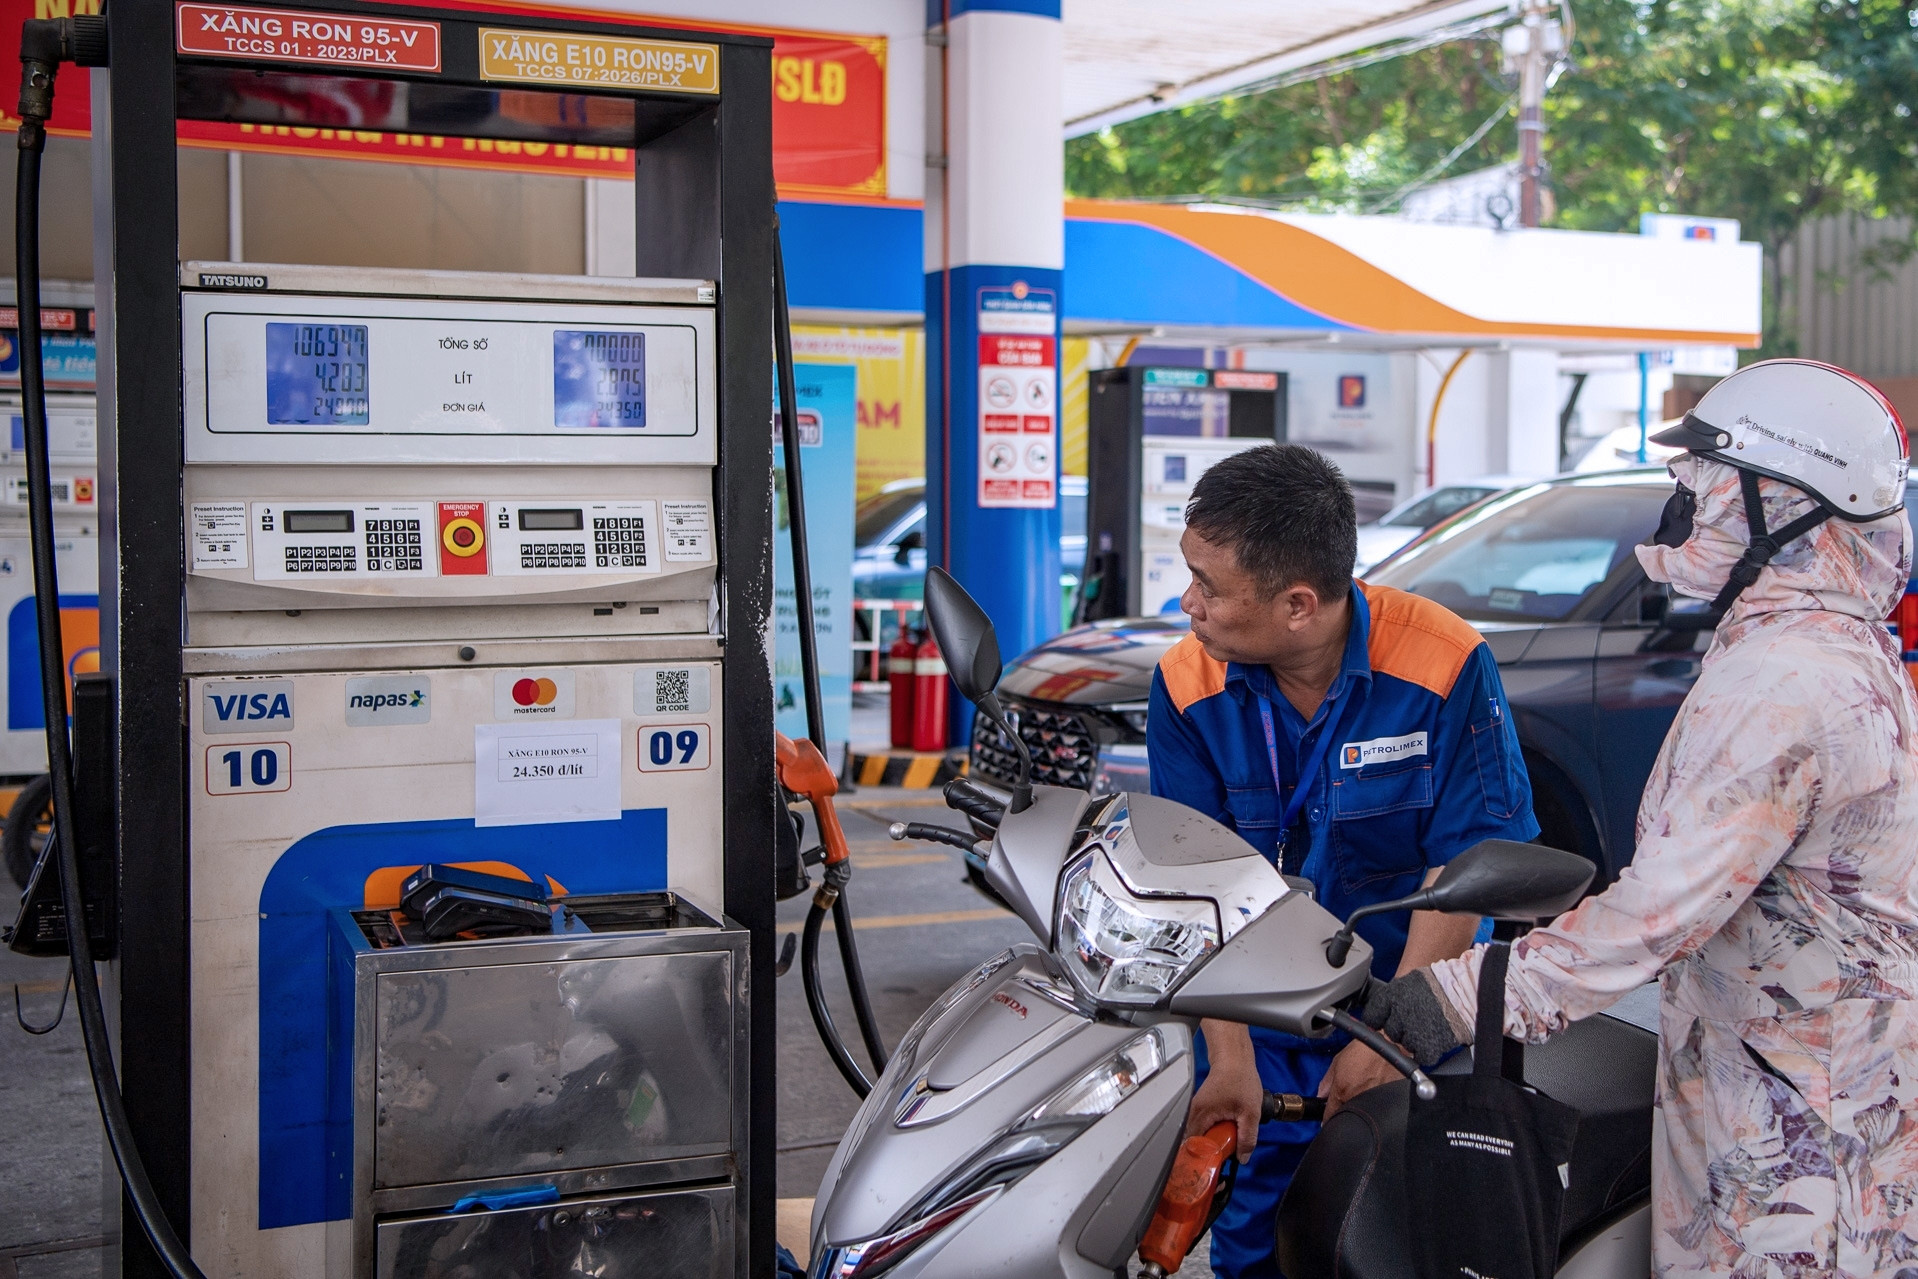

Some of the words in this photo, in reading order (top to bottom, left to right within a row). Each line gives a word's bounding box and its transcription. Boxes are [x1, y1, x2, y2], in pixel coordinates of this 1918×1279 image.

[200, 11, 283, 36] XĂNG
[292, 20, 352, 42] RON
[360, 27, 418, 48] 95-V
[224, 38, 276, 54] TCCS
[280, 42, 300, 55] 01
[318, 45, 397, 62] 2023/PLX
[492, 35, 558, 63] XĂNG
[566, 44, 606, 67] E10
[614, 48, 708, 74] RON95-V
[514, 63, 567, 78] TCCS
[773, 56, 847, 106] SLĐ
[202, 275, 264, 288] TATSUNO
[294, 327, 365, 356] 106947
[438, 337, 469, 350] TỔNG
[474, 338, 488, 350] SỐ
[455, 371, 472, 384] LÍT
[443, 403, 465, 412] ĐƠN
[468, 402, 486, 412] GIÁ
[1752, 422, 1775, 439] Driving
[1814, 448, 1834, 462] QUANG
[1834, 456, 1848, 468] VINH
[368, 521, 375, 530] 7
[382, 521, 389, 530] 8
[396, 521, 403, 530] 9
[596, 520, 602, 528] 7
[609, 519, 616, 528] 8
[622, 519, 628, 528] 9
[369, 534, 376, 543] 4
[383, 534, 390, 543] 5
[397, 534, 404, 543] 6
[597, 532, 604, 541] 4
[610, 532, 616, 540] 5
[623, 532, 629, 540] 6
[287, 549, 297, 557] P1
[301, 549, 311, 557] P2
[315, 549, 326, 557] P3
[329, 549, 340, 557] P4
[344, 549, 354, 557] P5
[370, 547, 375, 556] 1
[384, 547, 390, 556] 2
[398, 547, 404, 556] 3
[598, 545, 603, 553] 1
[611, 545, 617, 553] 2
[624, 545, 630, 553] 3
[370, 561, 377, 570] 0
[384, 560, 392, 569] C
[523, 558, 533, 566] P6
[536, 558, 546, 566] P7
[549, 558, 559, 566] P8
[562, 558, 572, 566] P9
[574, 558, 585, 566] P10
[599, 557, 605, 566] 0
[611, 557, 619, 565] C
[207, 694, 291, 720] VISA
[350, 693, 407, 711] napas
[514, 706, 556, 714] mastercard
[508, 749, 532, 758] XĂNG
[650, 730, 698, 765] 09
[222, 749, 278, 788] 10
[513, 765, 554, 778] 24.350
[1483, 1144, 1511, 1156] POSSIBLE
